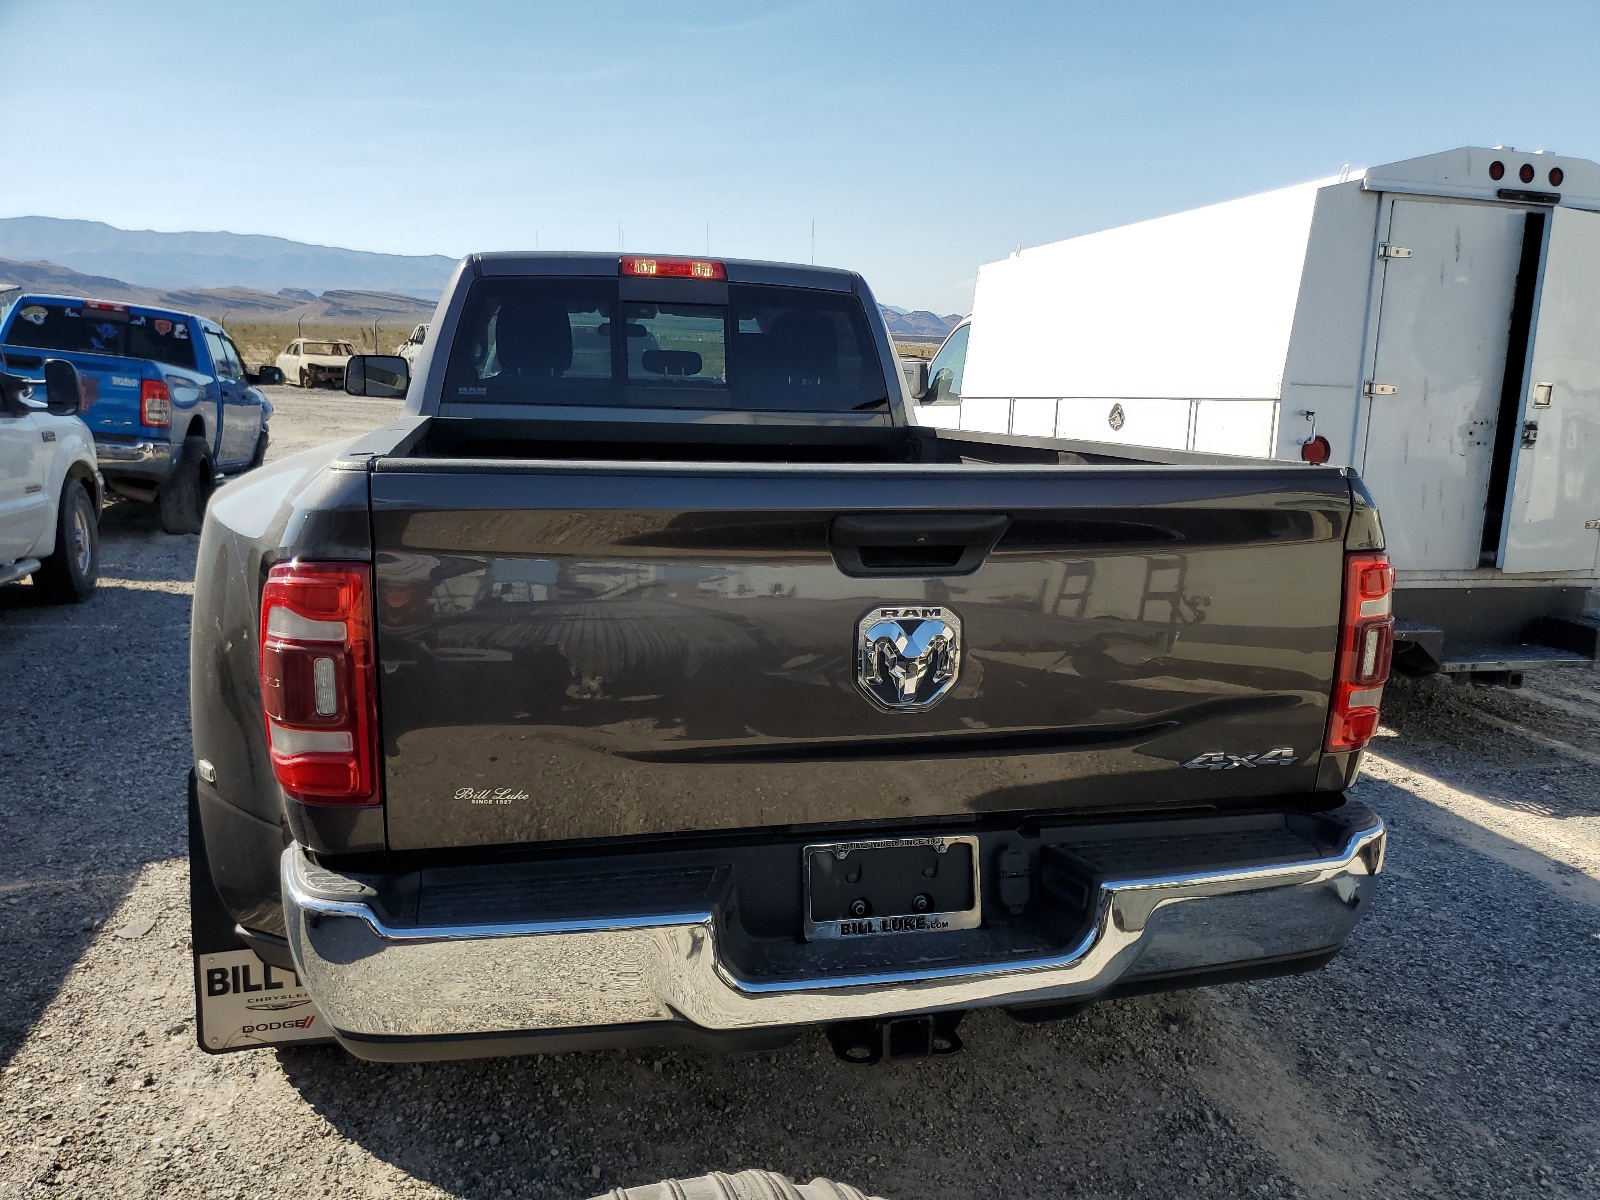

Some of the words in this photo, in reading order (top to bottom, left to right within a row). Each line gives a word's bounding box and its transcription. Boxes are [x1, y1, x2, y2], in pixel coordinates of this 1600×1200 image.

[880, 608, 942, 618] RAM
[454, 787, 492, 800] Bill
[492, 787, 530, 800] Luke
[899, 838, 925, 847] SINCE
[840, 921, 877, 936] BILL
[207, 964, 284, 997] BILL
[242, 1019, 306, 1033] DODGE
